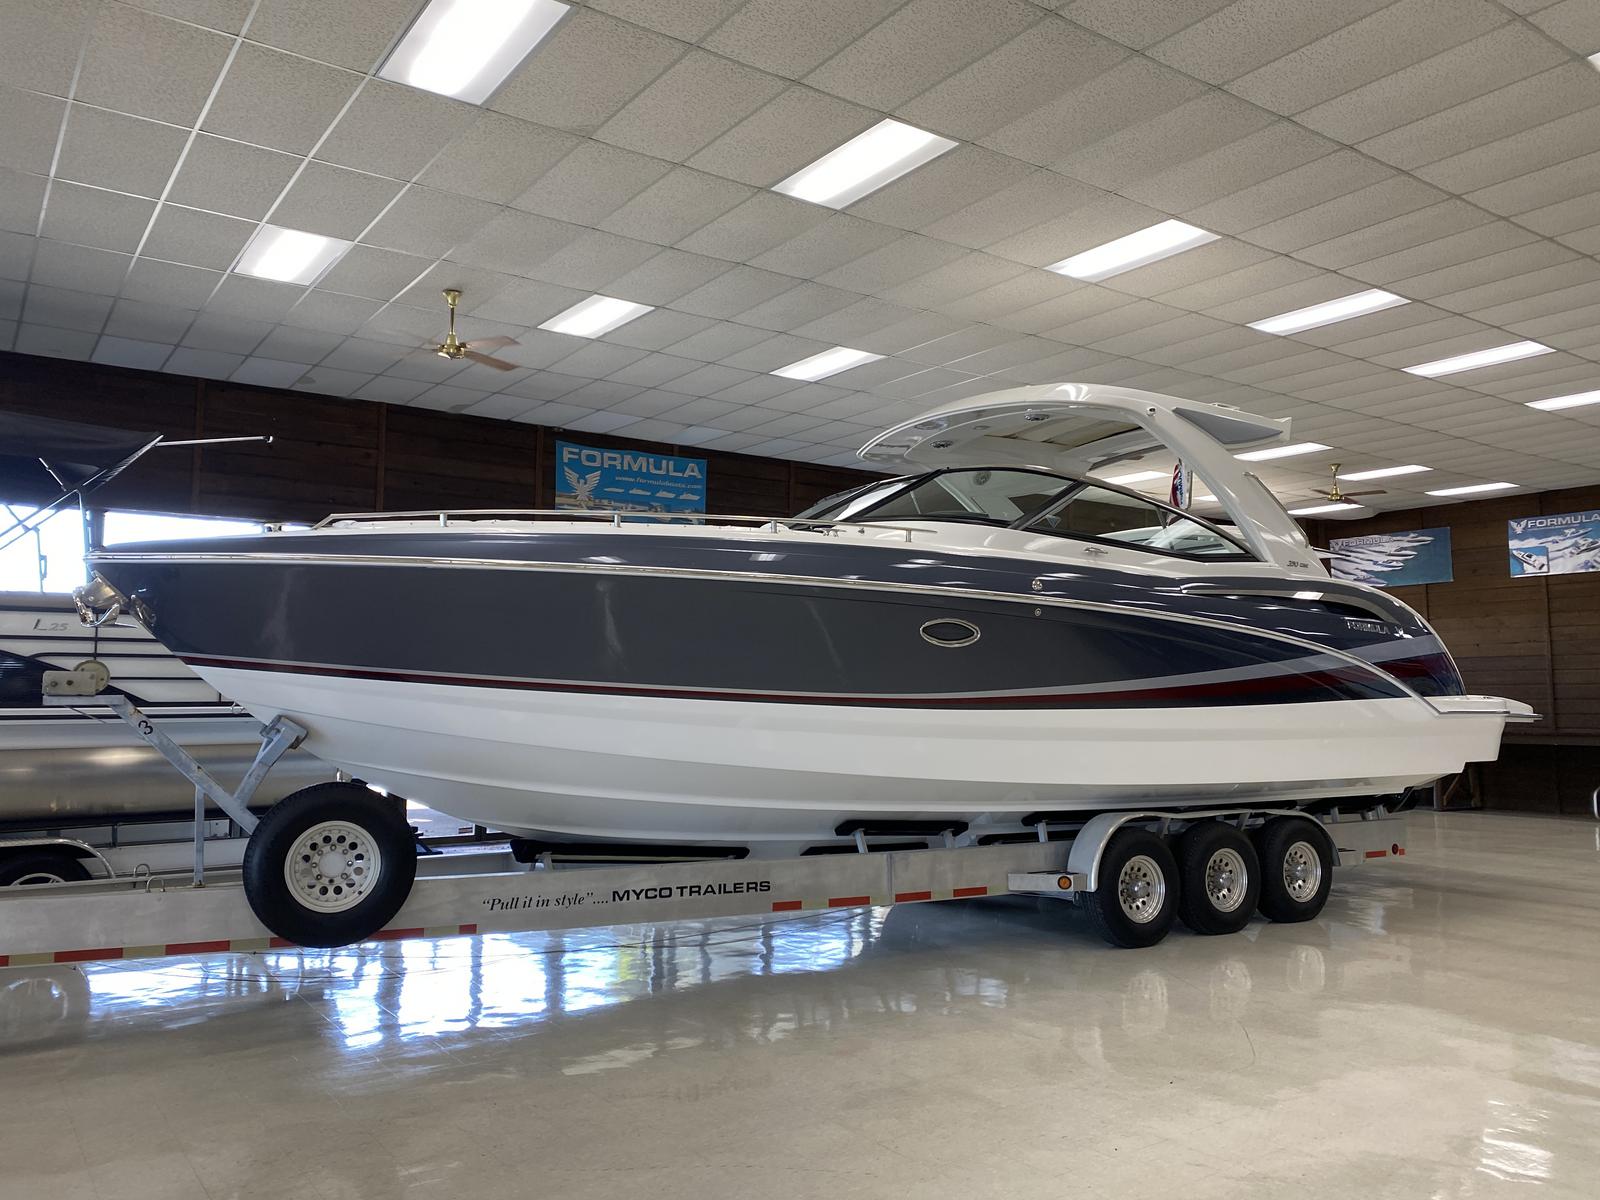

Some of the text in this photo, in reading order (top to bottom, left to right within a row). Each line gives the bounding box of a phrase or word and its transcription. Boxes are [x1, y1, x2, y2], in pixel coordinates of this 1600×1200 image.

[562, 447, 703, 479] FORMULA
[1527, 513, 1600, 528] FORMULA
[1342, 536, 1394, 547] FORMULA
[138, 720, 153, 735] 3
[522, 895, 534, 909] it
[535, 895, 550, 908] in
[612, 887, 673, 902] MYCO
[676, 880, 771, 897] TRAILERS
